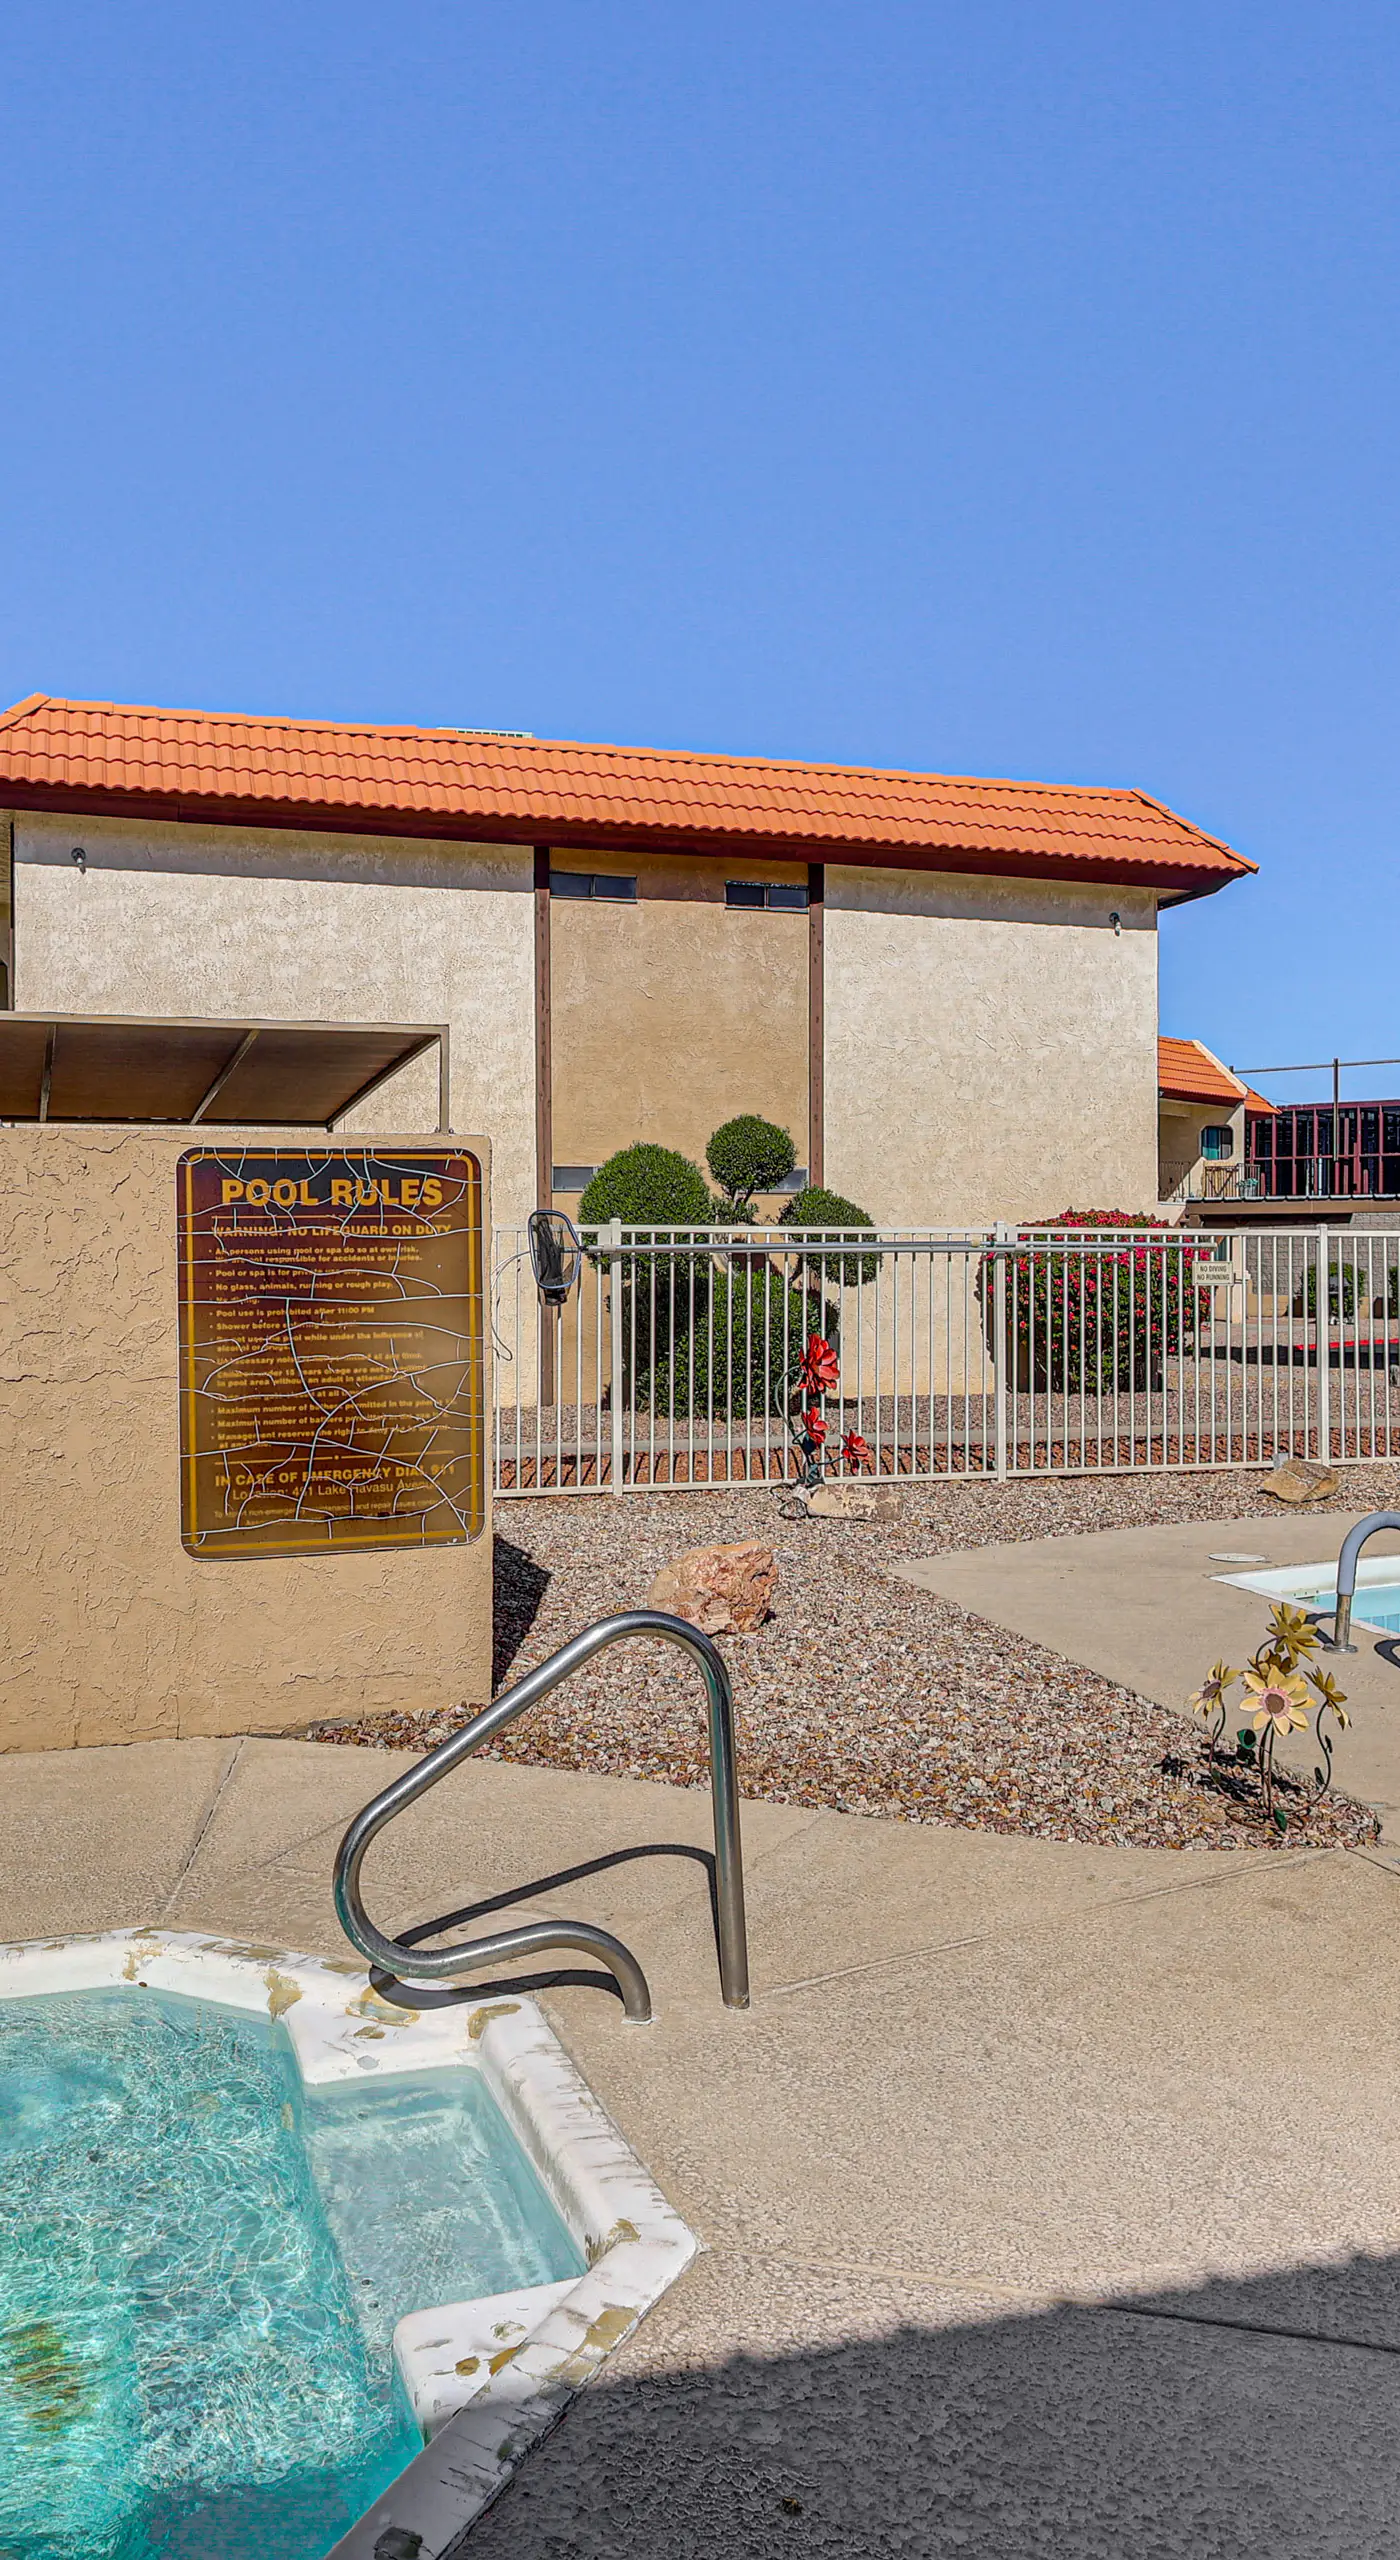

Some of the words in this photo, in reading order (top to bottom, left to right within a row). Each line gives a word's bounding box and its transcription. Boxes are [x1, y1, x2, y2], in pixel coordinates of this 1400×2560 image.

[222, 1178, 318, 1206] POOL
[331, 1178, 442, 1206] RULES
[212, 1226, 283, 1237] WARNING:
[287, 1226, 308, 1237] NO
[312, 1225, 388, 1237] LIFEGUARD
[392, 1225, 412, 1235] ON
[415, 1224, 452, 1235] DUTY
[229, 1248, 265, 1256] persons
[267, 1247, 292, 1256] using
[294, 1246, 312, 1256] pool
[326, 1246, 342, 1255] spa
[249, 1270, 265, 1278] spa
[230, 1283, 257, 1291] glass,
[260, 1282, 297, 1290] animals,
[346, 1280, 371, 1289] rough
[267, 1308, 311, 1317] prohbited
[216, 1323, 250, 1331] Shower
[299, 1403, 308, 1411] of
[215, 1475, 230, 1487] IN
[235, 1472, 275, 1486] CASE
[278, 1470, 298, 1484] OF
[318, 1484, 347, 1496] Lake
